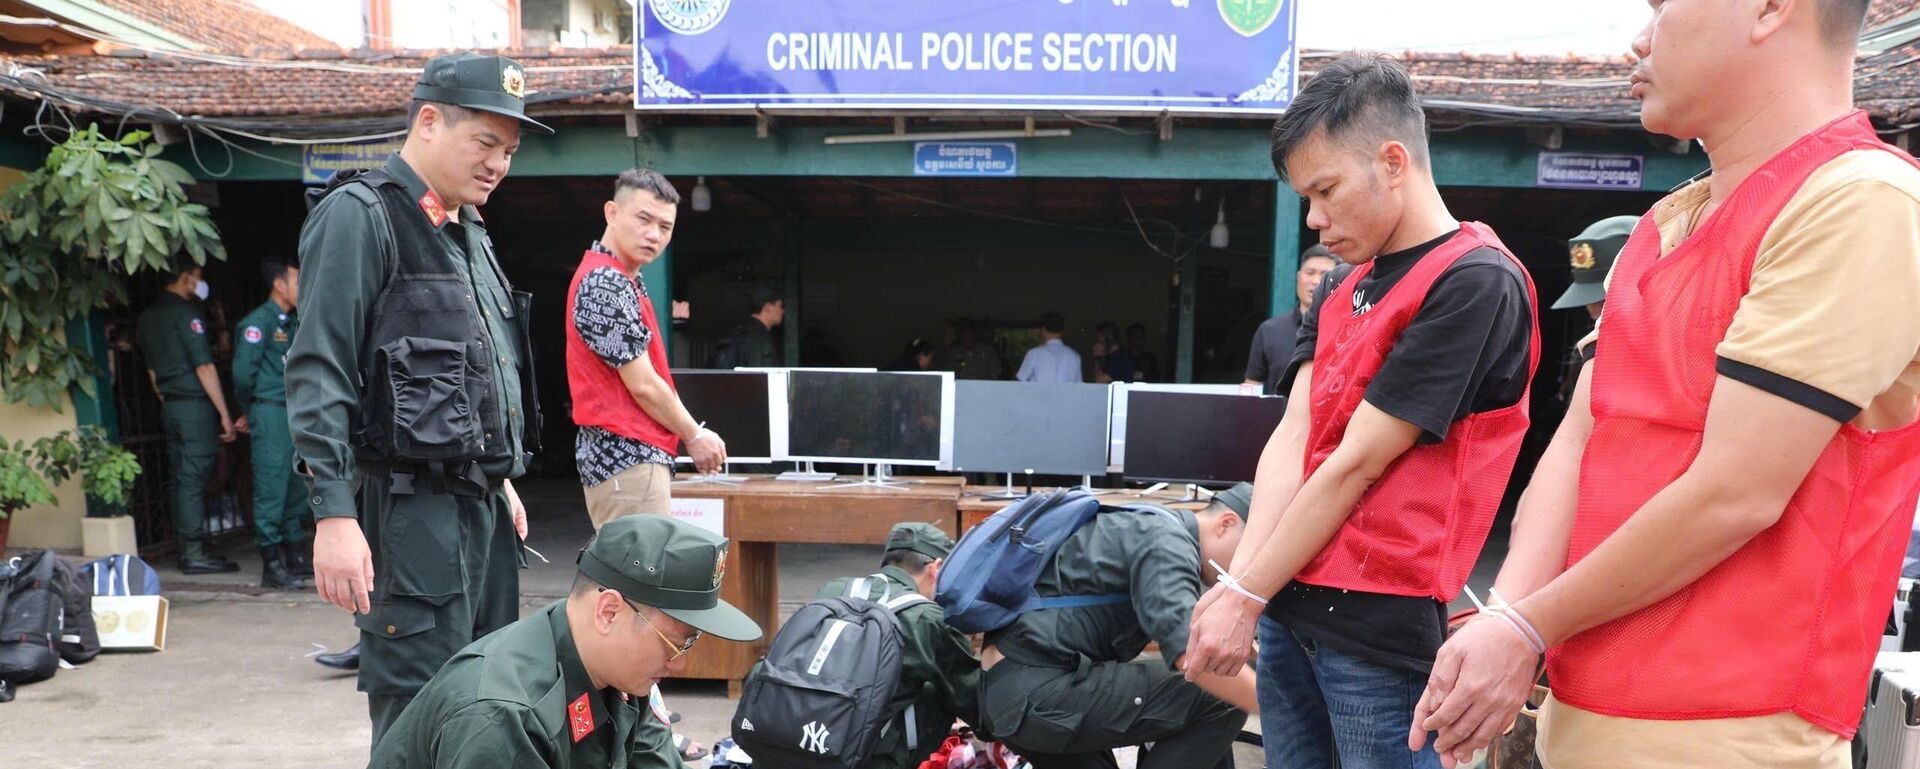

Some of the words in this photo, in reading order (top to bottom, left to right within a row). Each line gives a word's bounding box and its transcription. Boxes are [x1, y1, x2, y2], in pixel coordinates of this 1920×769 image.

[766, 31, 913, 71] CRIMINAL
[921, 31, 1033, 71] POLICE
[1042, 32, 1177, 72] SECTION
[799, 721, 830, 754] NY
